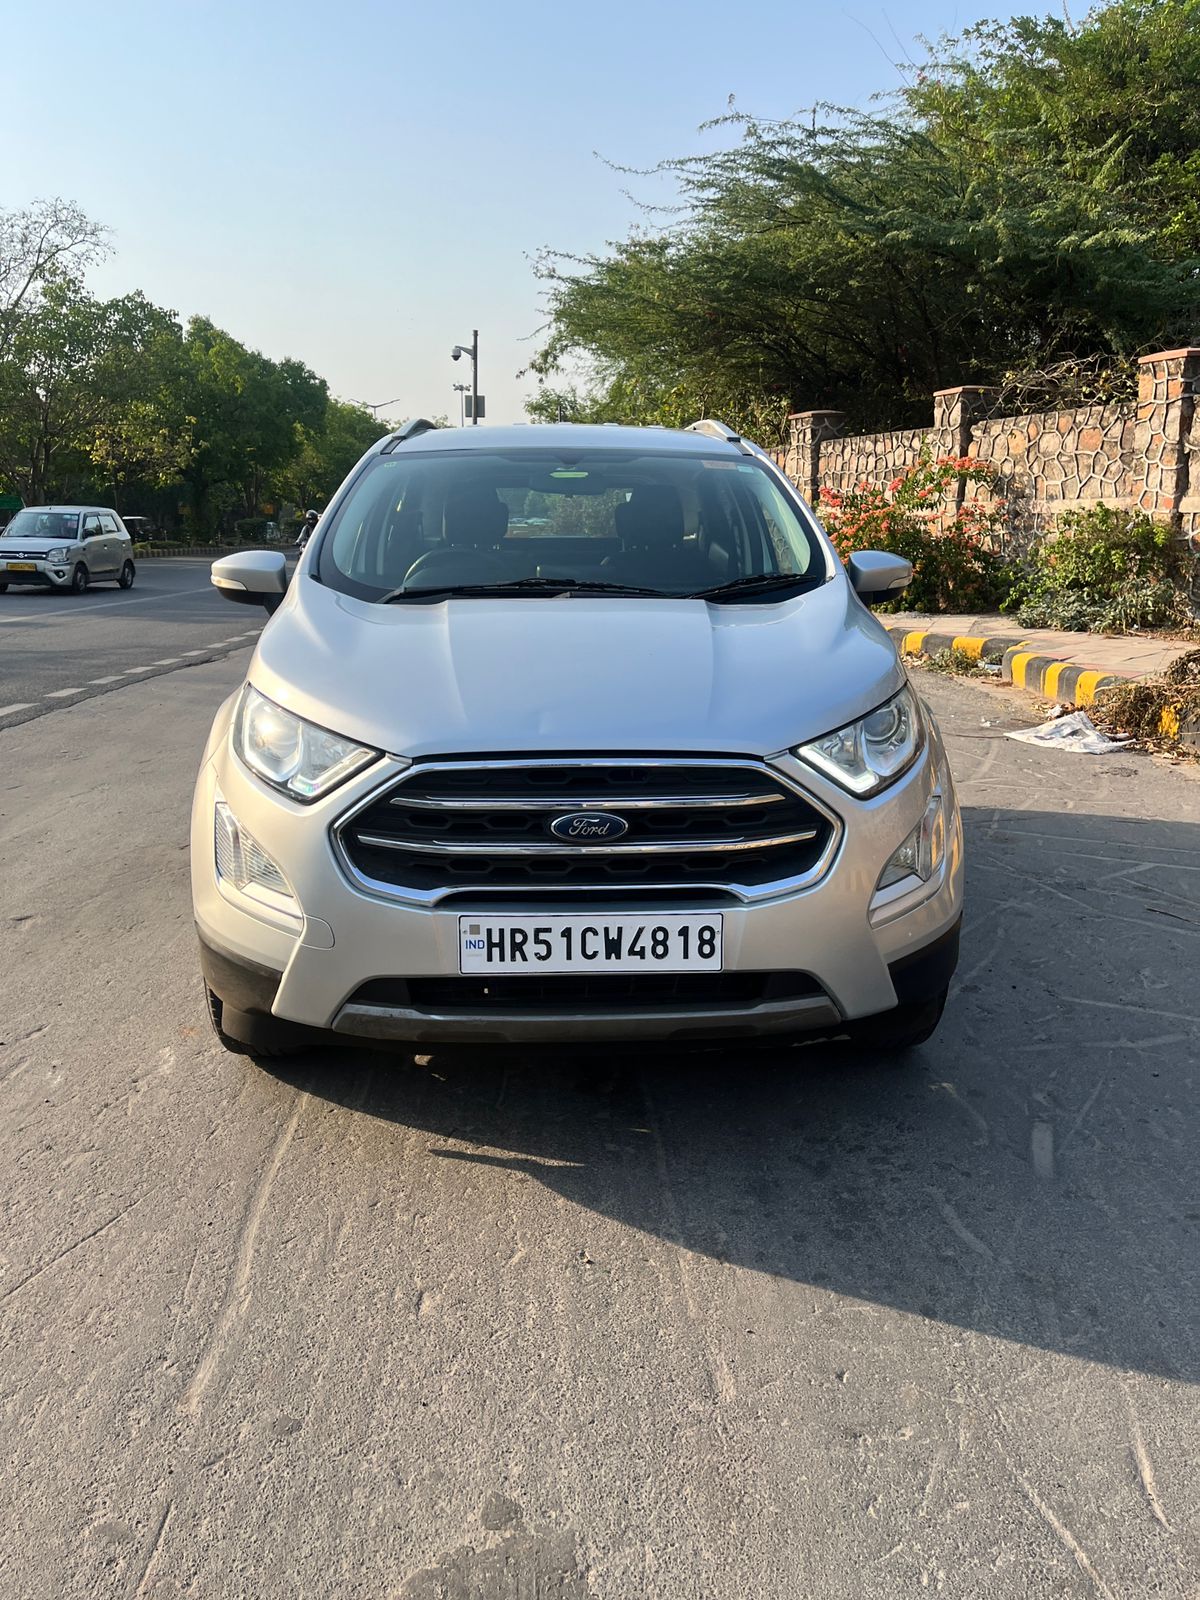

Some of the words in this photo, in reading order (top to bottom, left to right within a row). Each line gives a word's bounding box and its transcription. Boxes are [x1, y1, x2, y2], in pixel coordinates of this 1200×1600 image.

[568, 817, 610, 836] Ford
[465, 939, 485, 950] IND
[486, 925, 716, 963] HR51CW4818
